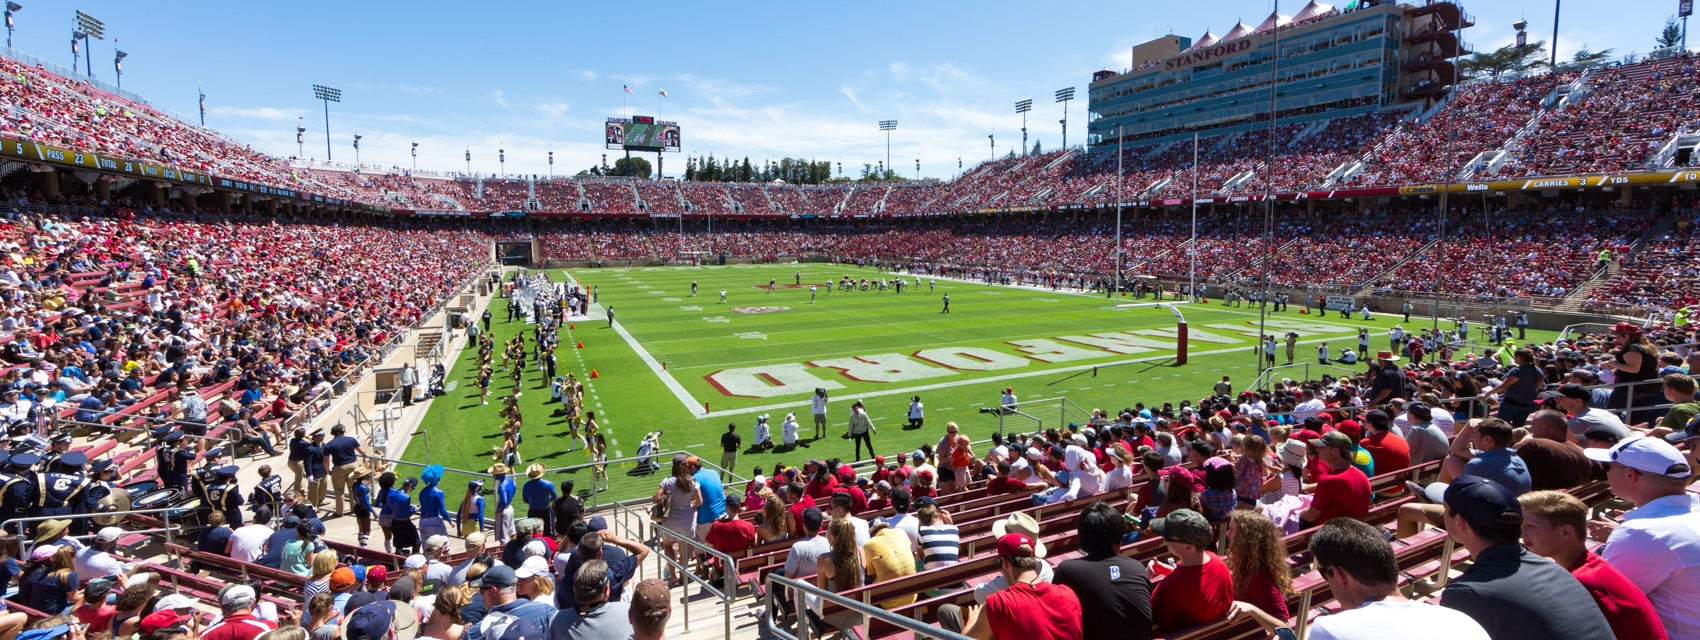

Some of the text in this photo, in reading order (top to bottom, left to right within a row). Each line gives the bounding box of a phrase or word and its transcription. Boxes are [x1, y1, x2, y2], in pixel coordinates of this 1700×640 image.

[1165, 39, 1252, 70] STANFORD
[16, 143, 23, 154] 5
[46, 149, 84, 164] PASS 23
[101, 159, 133, 172] TOTAL 28
[1533, 178, 1586, 188] CARRIES 3
[1610, 176, 1629, 184] YDS
[1684, 173, 1697, 181] TD
[1467, 183, 1488, 191] Wells
[703, 320, 1357, 398] STANFORD
[1110, 566, 1120, 580] B
